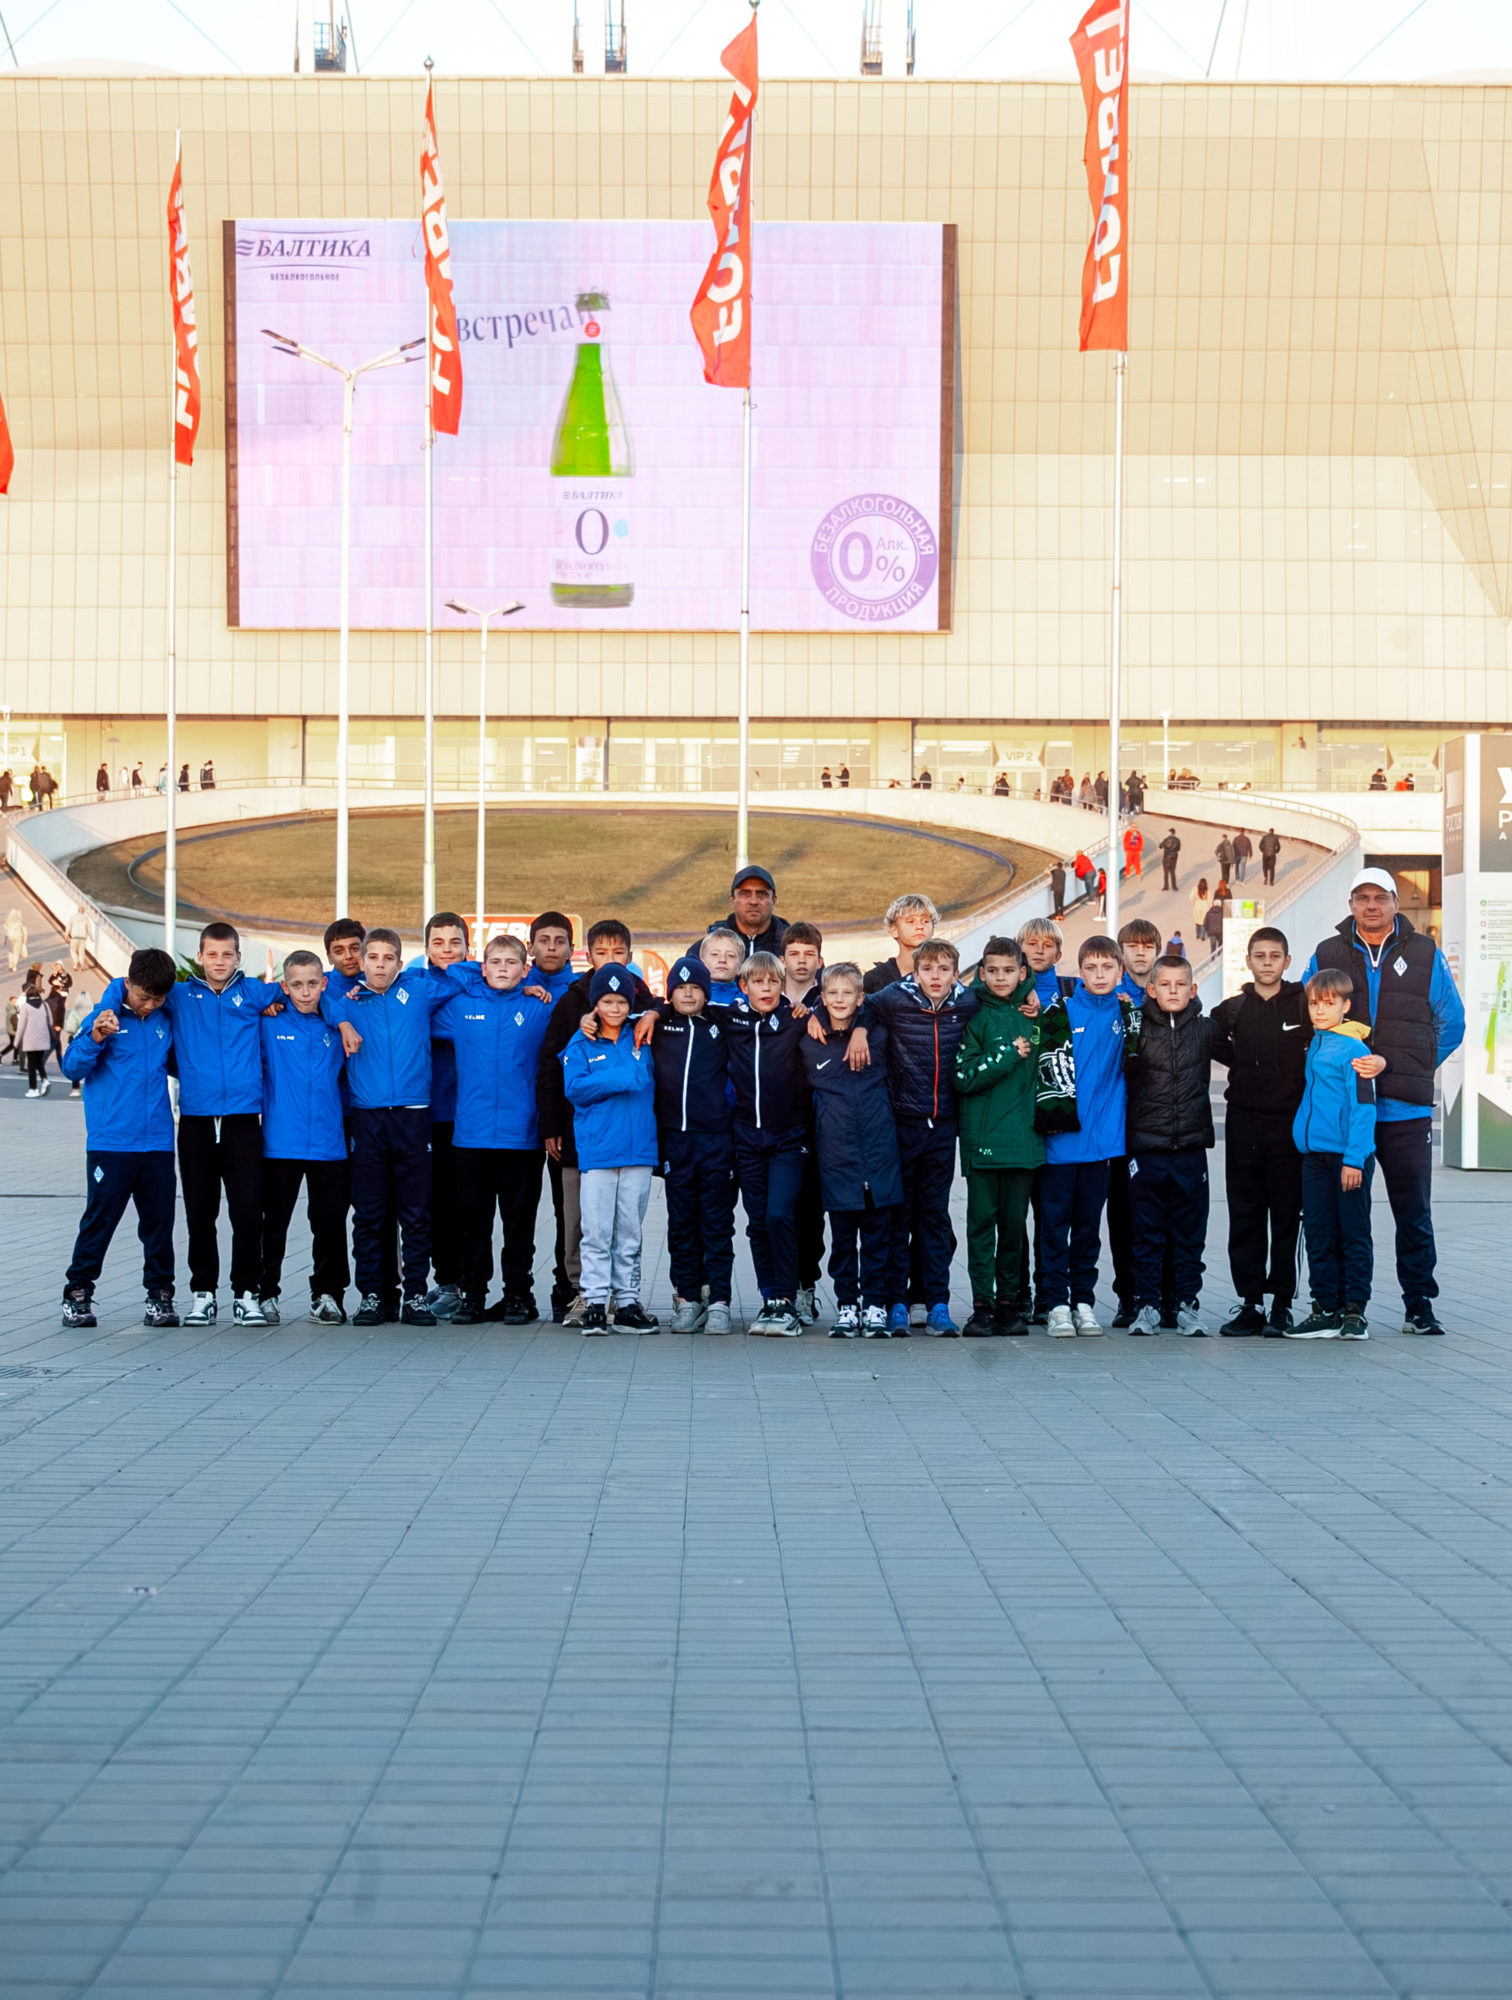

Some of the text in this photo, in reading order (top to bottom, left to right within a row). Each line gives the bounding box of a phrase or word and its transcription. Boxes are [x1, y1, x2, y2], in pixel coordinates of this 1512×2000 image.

[256, 239, 371, 257] БАЛТИКА
[270, 273, 340, 281] БЕЗАЛКОГОЛЬНОЕ
[575, 508, 609, 556] 0
[814, 497, 935, 556] БЕЗАЛКОГОЛЬНАЯ
[877, 536, 909, 551] Алк.
[825, 582, 926, 621] ПРОДУКЦИЯ
[1004, 751, 1034, 762] VIP 2
